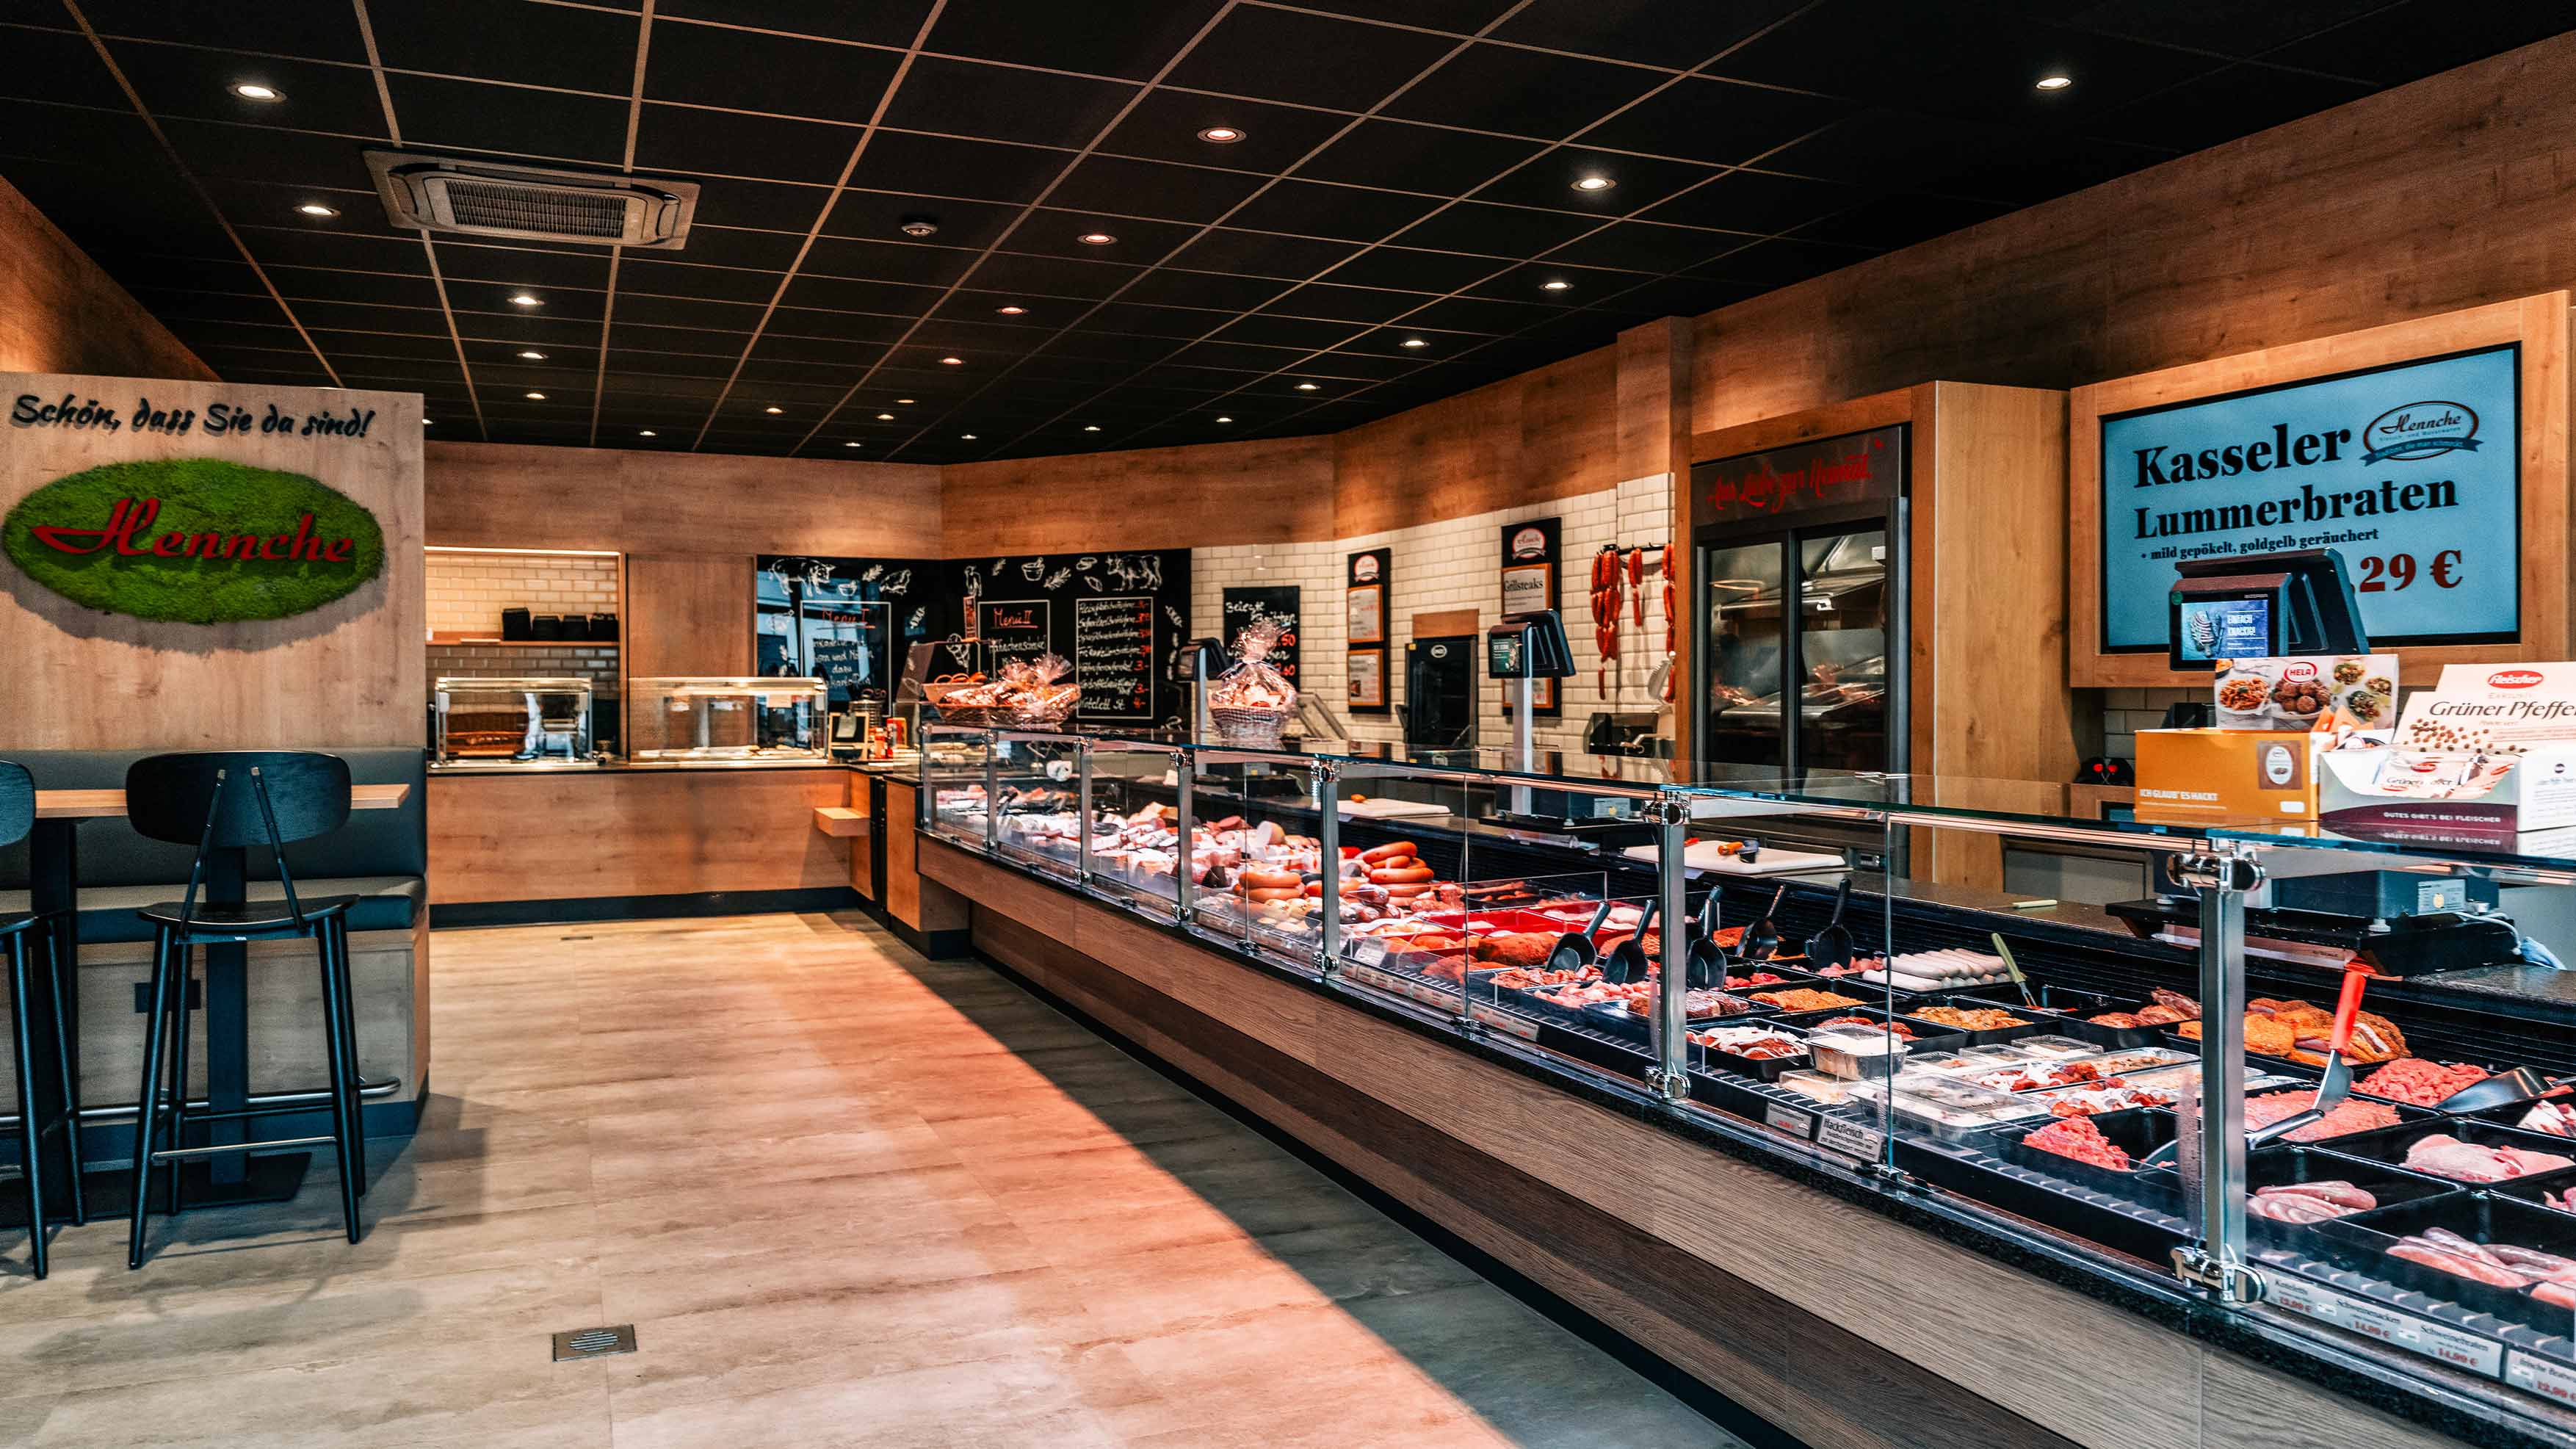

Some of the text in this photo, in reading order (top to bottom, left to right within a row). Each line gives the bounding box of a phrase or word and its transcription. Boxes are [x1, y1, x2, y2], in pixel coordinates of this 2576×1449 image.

[12, 393, 376, 438] Schön, dass Sie da sind!
[2379, 411, 2461, 434] Hennche
[2133, 423, 2351, 488] Kasseler
[2134, 479, 2459, 539] Lummerbraten
[30, 497, 354, 563] Hennche
[2151, 528, 2378, 560] mild gepökelt, goldgelb geräuchert
[1504, 577, 1544, 592] Grillsteaks
[2429, 549, 2463, 588] €
[2489, 673, 2543, 684] Fleischer
[2429, 701, 2576, 720] Grüner Pfeffe
[1824, 1117, 1864, 1139] Hackfleisch
